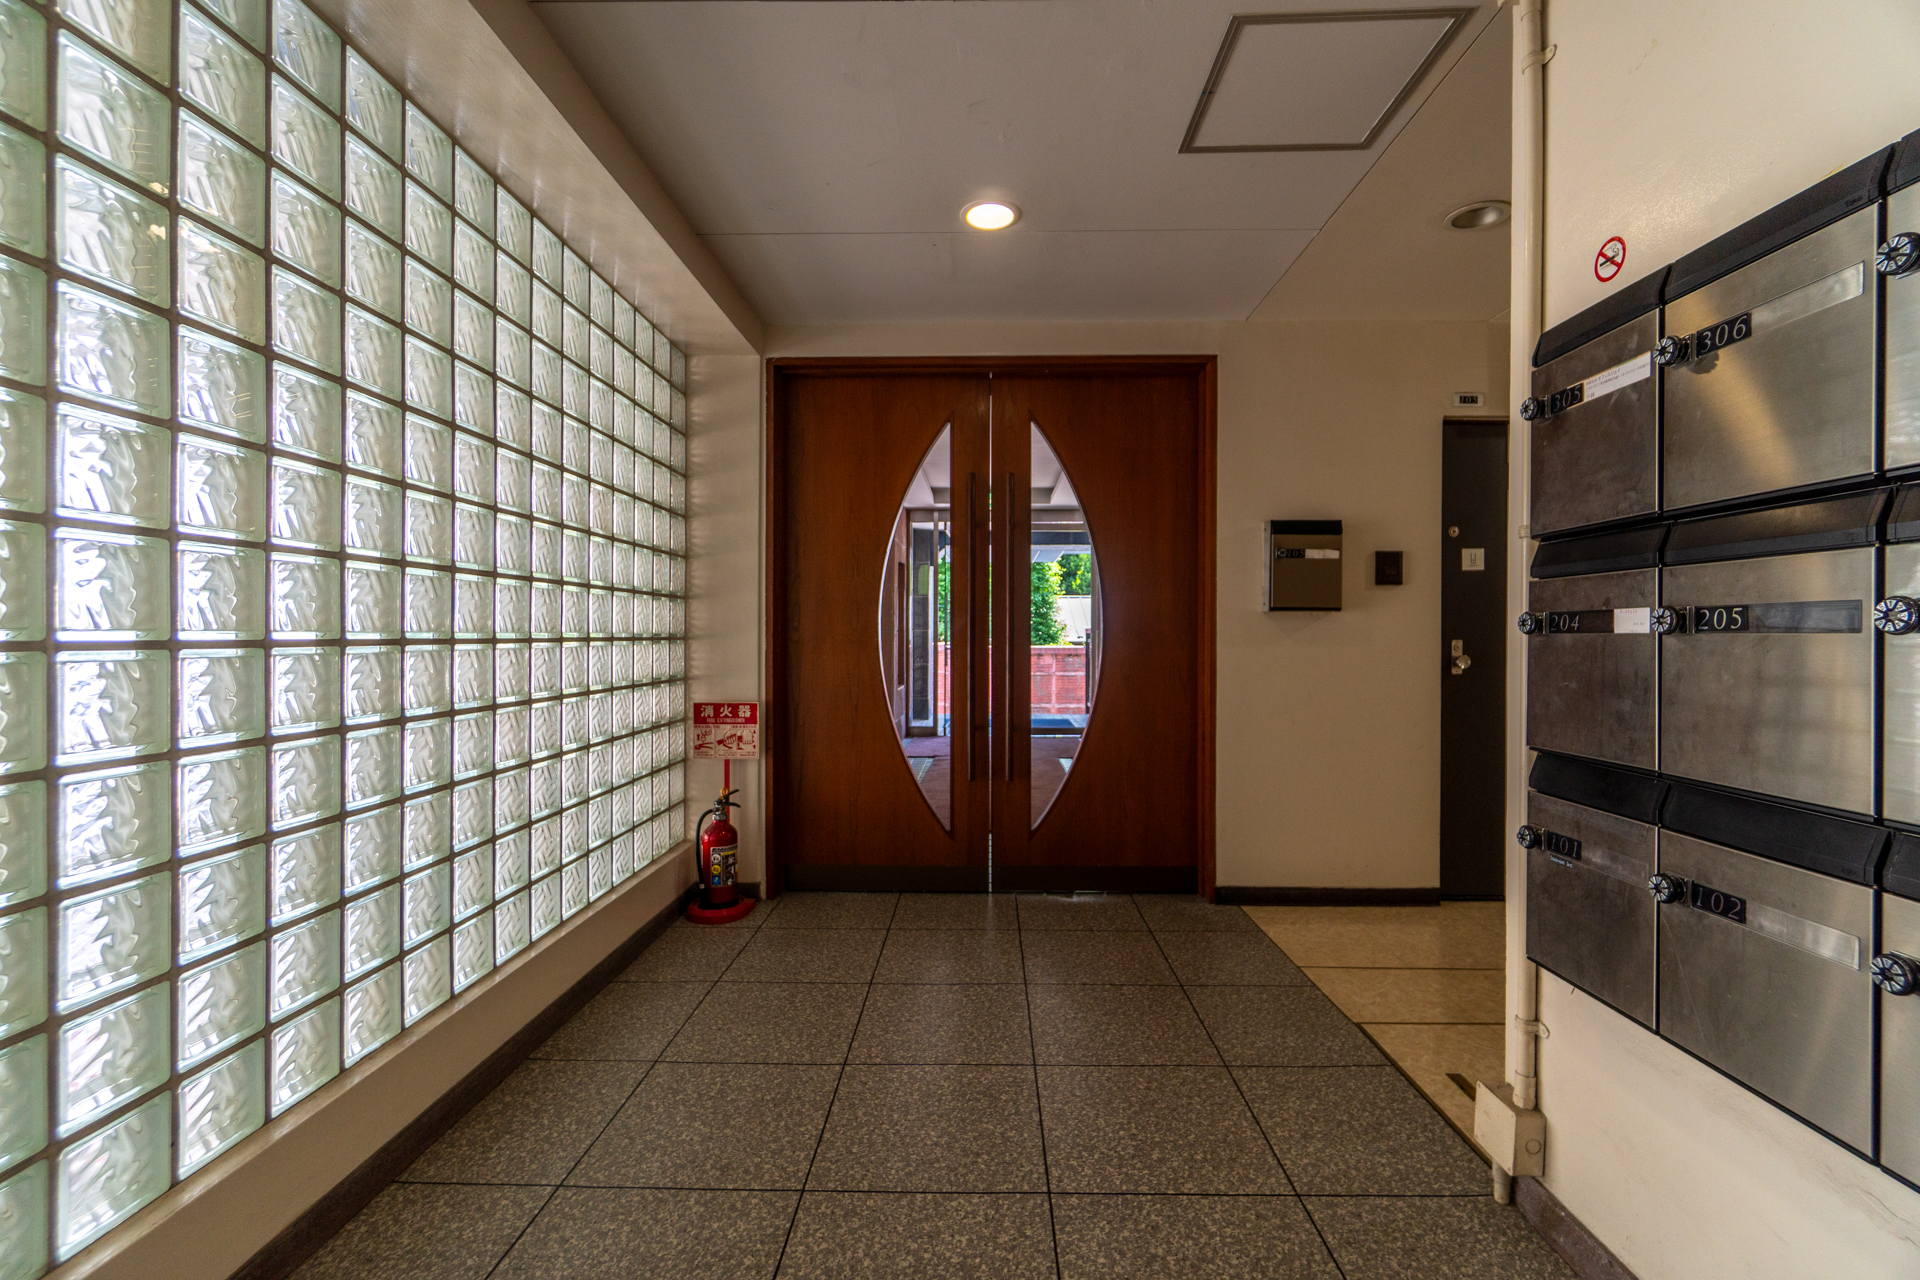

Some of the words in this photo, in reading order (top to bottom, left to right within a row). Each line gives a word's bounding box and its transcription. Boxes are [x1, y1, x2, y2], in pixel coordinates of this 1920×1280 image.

[1700, 315, 1748, 353] 306
[1553, 385, 1582, 412] 305
[1550, 614, 1580, 632] 204
[1698, 607, 1744, 630] 205
[700, 704, 752, 718] 消火器
[1550, 834, 1578, 858] 101
[1695, 887, 1741, 920] 102
